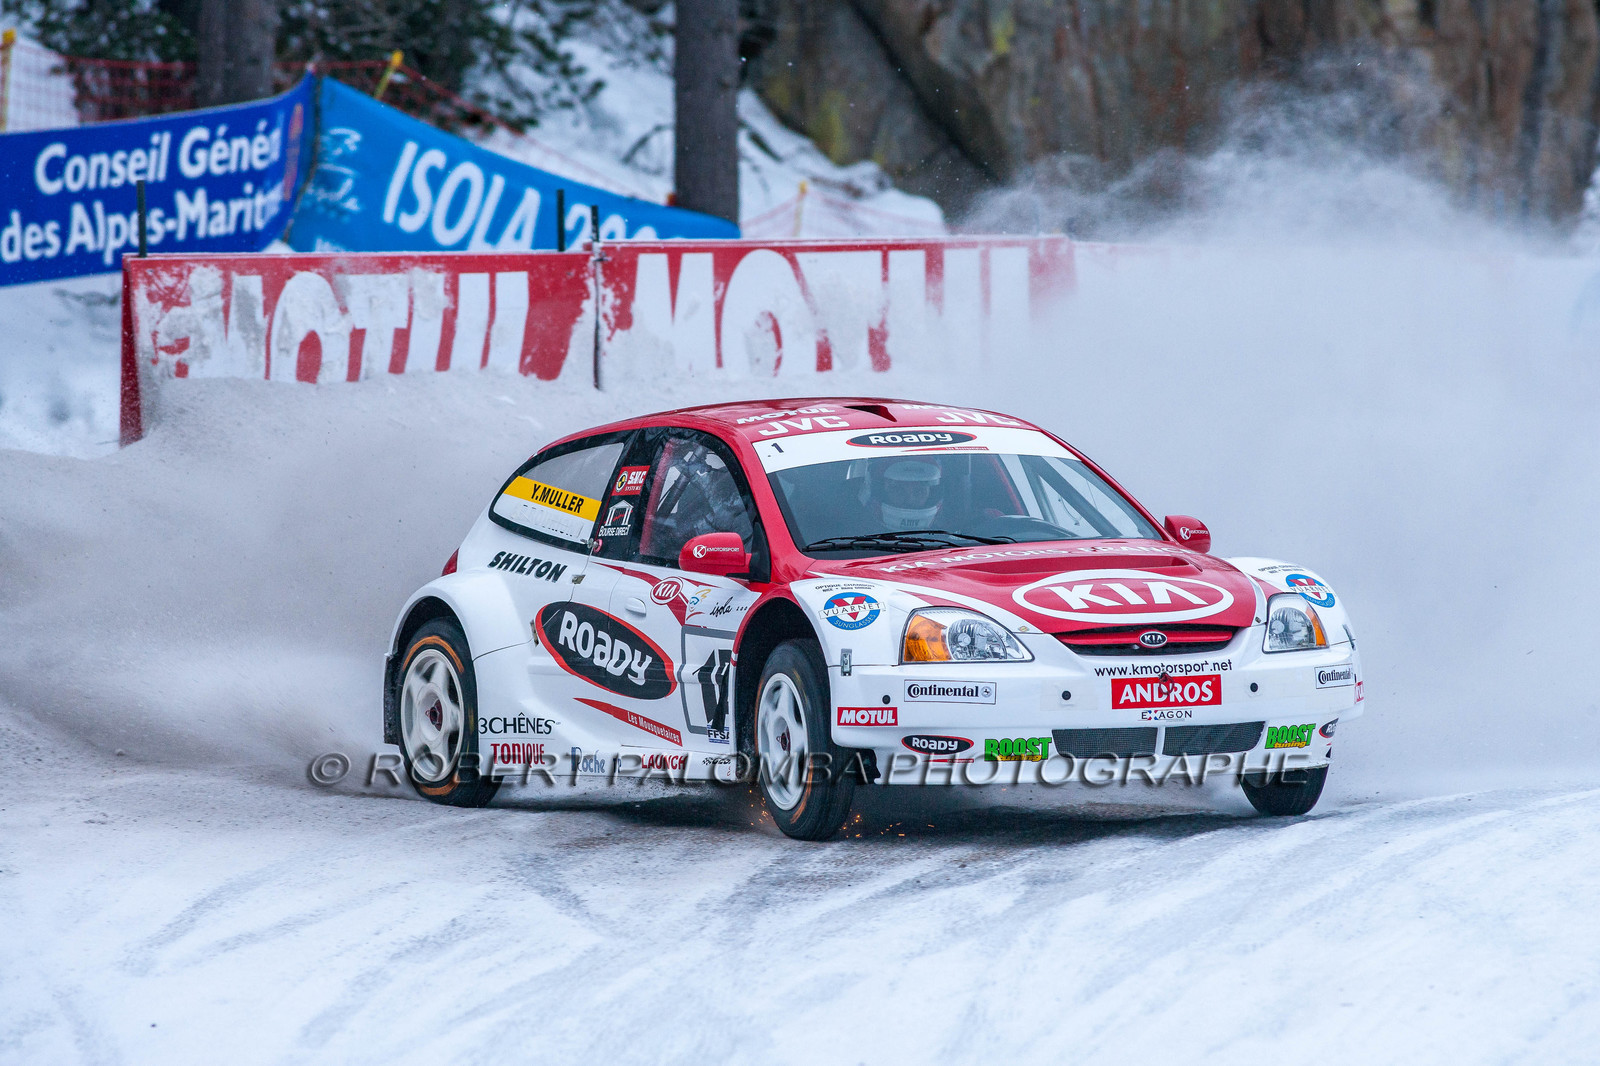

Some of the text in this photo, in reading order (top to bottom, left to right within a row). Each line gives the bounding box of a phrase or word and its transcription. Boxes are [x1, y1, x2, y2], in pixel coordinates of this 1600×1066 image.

[35, 131, 172, 195] Conseil
[382, 140, 541, 250] ISOLA
[1, 210, 62, 264] des
[736, 408, 836, 424] MOTUL
[936, 411, 1021, 426] JVC
[758, 415, 850, 436] JVC
[530, 483, 585, 514] Y.MULLER
[487, 550, 568, 584] SHILTON
[880, 560, 937, 573] KIA
[654, 583, 678, 598] KIA
[1045, 581, 1209, 610] KIA
[823, 602, 881, 617] VUARNET
[834, 613, 876, 629] SUNGLASSES
[1144, 633, 1163, 643] KIA
[1095, 660, 1233, 677] www.kmotorsport.net
[908, 683, 979, 698] Continental
[1118, 680, 1214, 705] ANDROS
[839, 709, 896, 724] MOTUL
[1141, 710, 1193, 720] EXAGON
[627, 711, 680, 743] Les Mousquetaires
[1265, 723, 1316, 749] BOOST
[1274, 740, 1306, 748] tuning
[984, 737, 1052, 761] BOOST
[641, 754, 688, 770] LAUNCH
